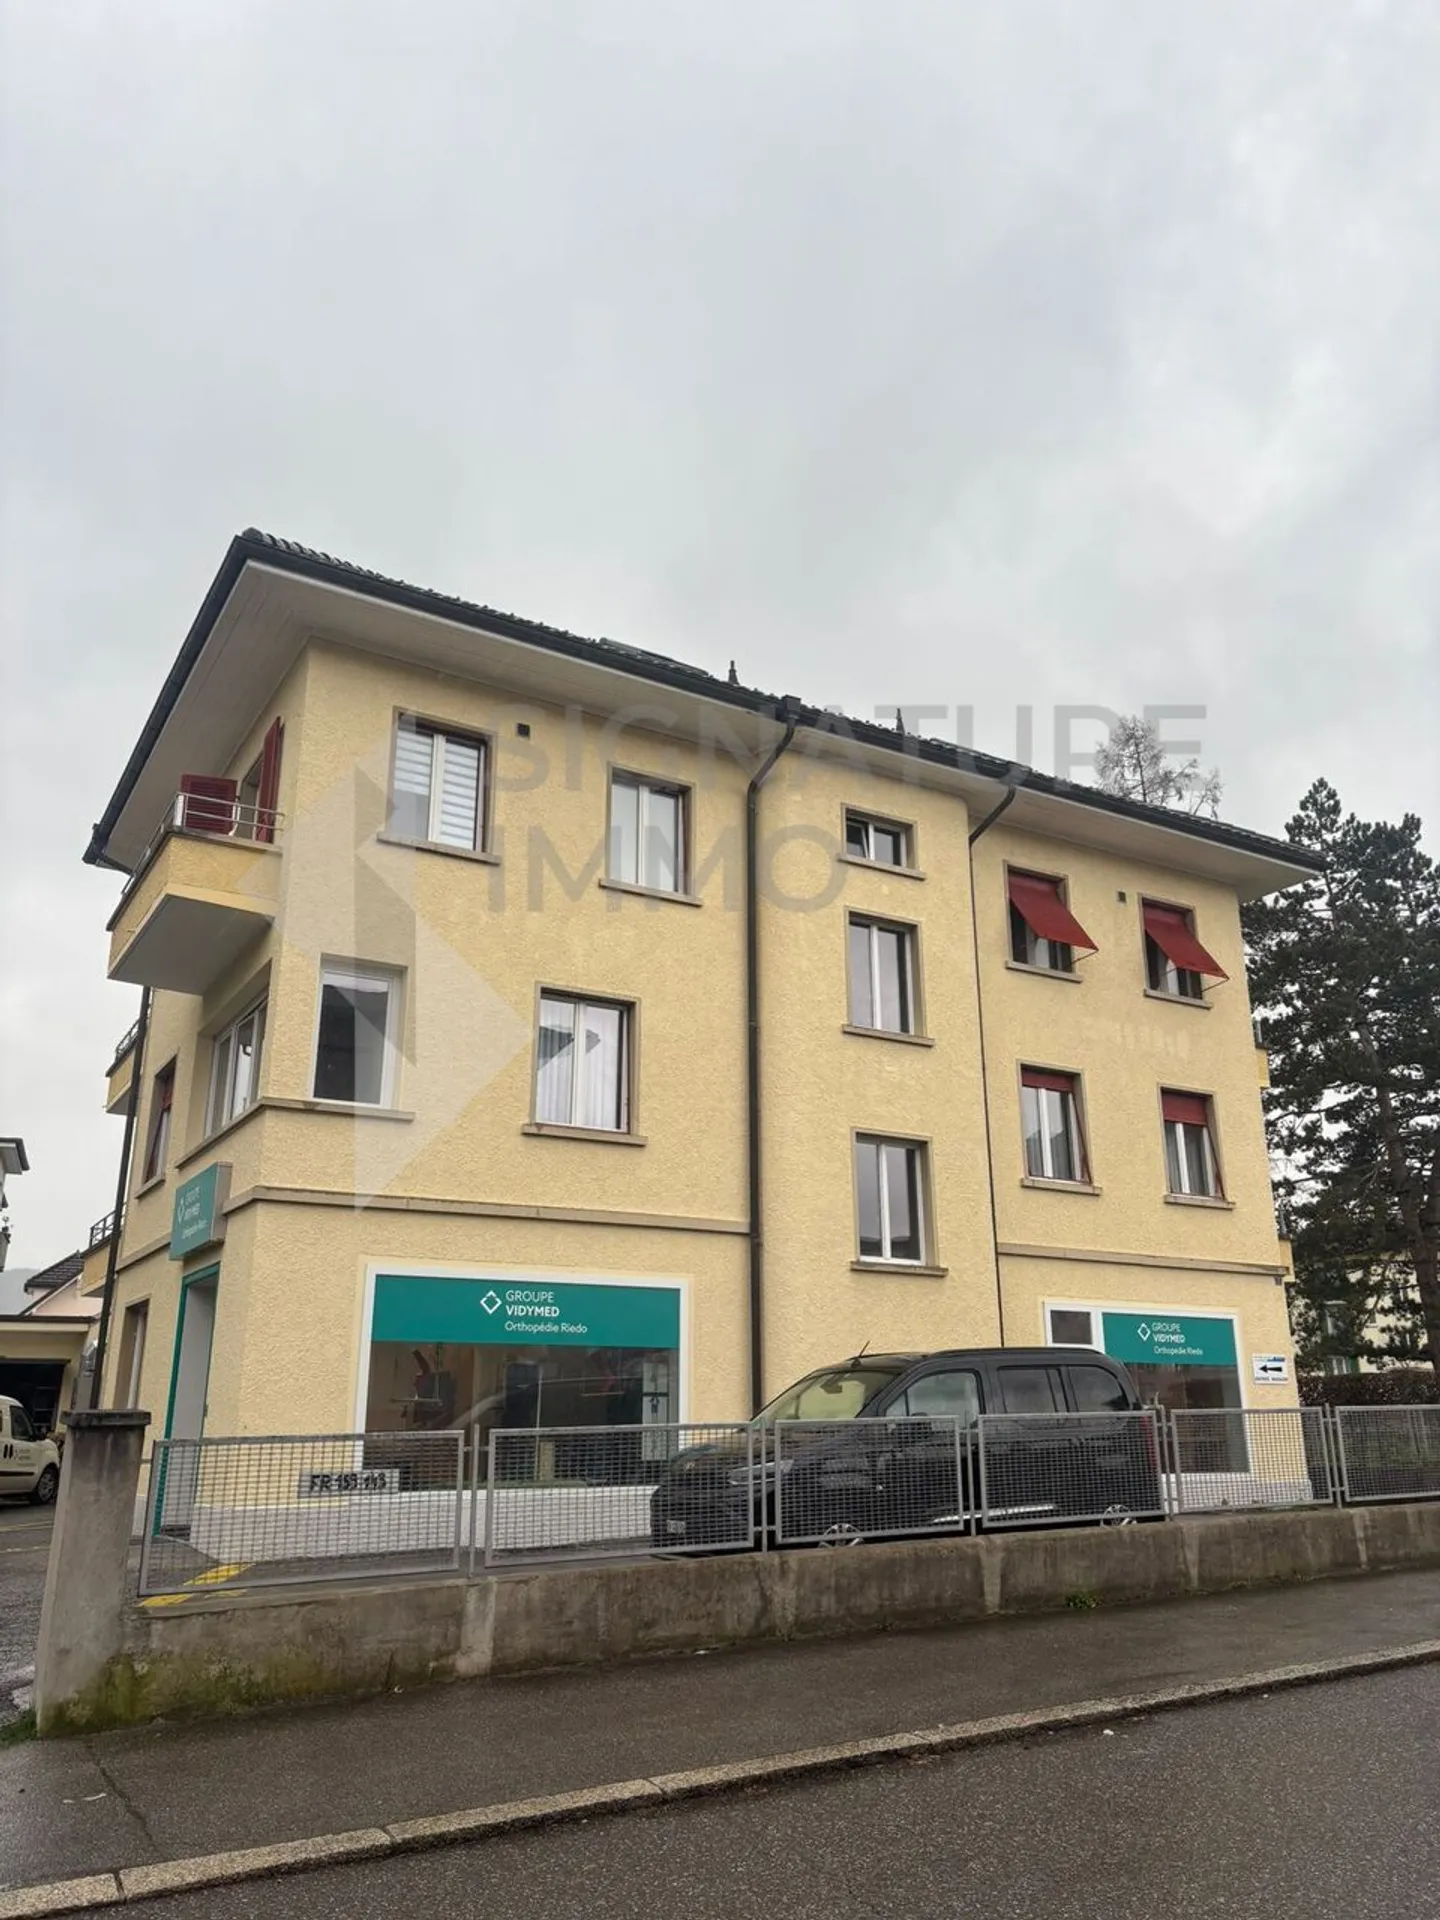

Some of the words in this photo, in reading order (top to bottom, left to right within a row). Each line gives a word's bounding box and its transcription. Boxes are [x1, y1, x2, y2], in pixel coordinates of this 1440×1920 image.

[505, 1290, 555, 1303] GROUPE
[505, 1304, 561, 1317] VIDYMED
[504, 1321, 559, 1334] Orthopédie
[560, 1322, 588, 1333] Riedo
